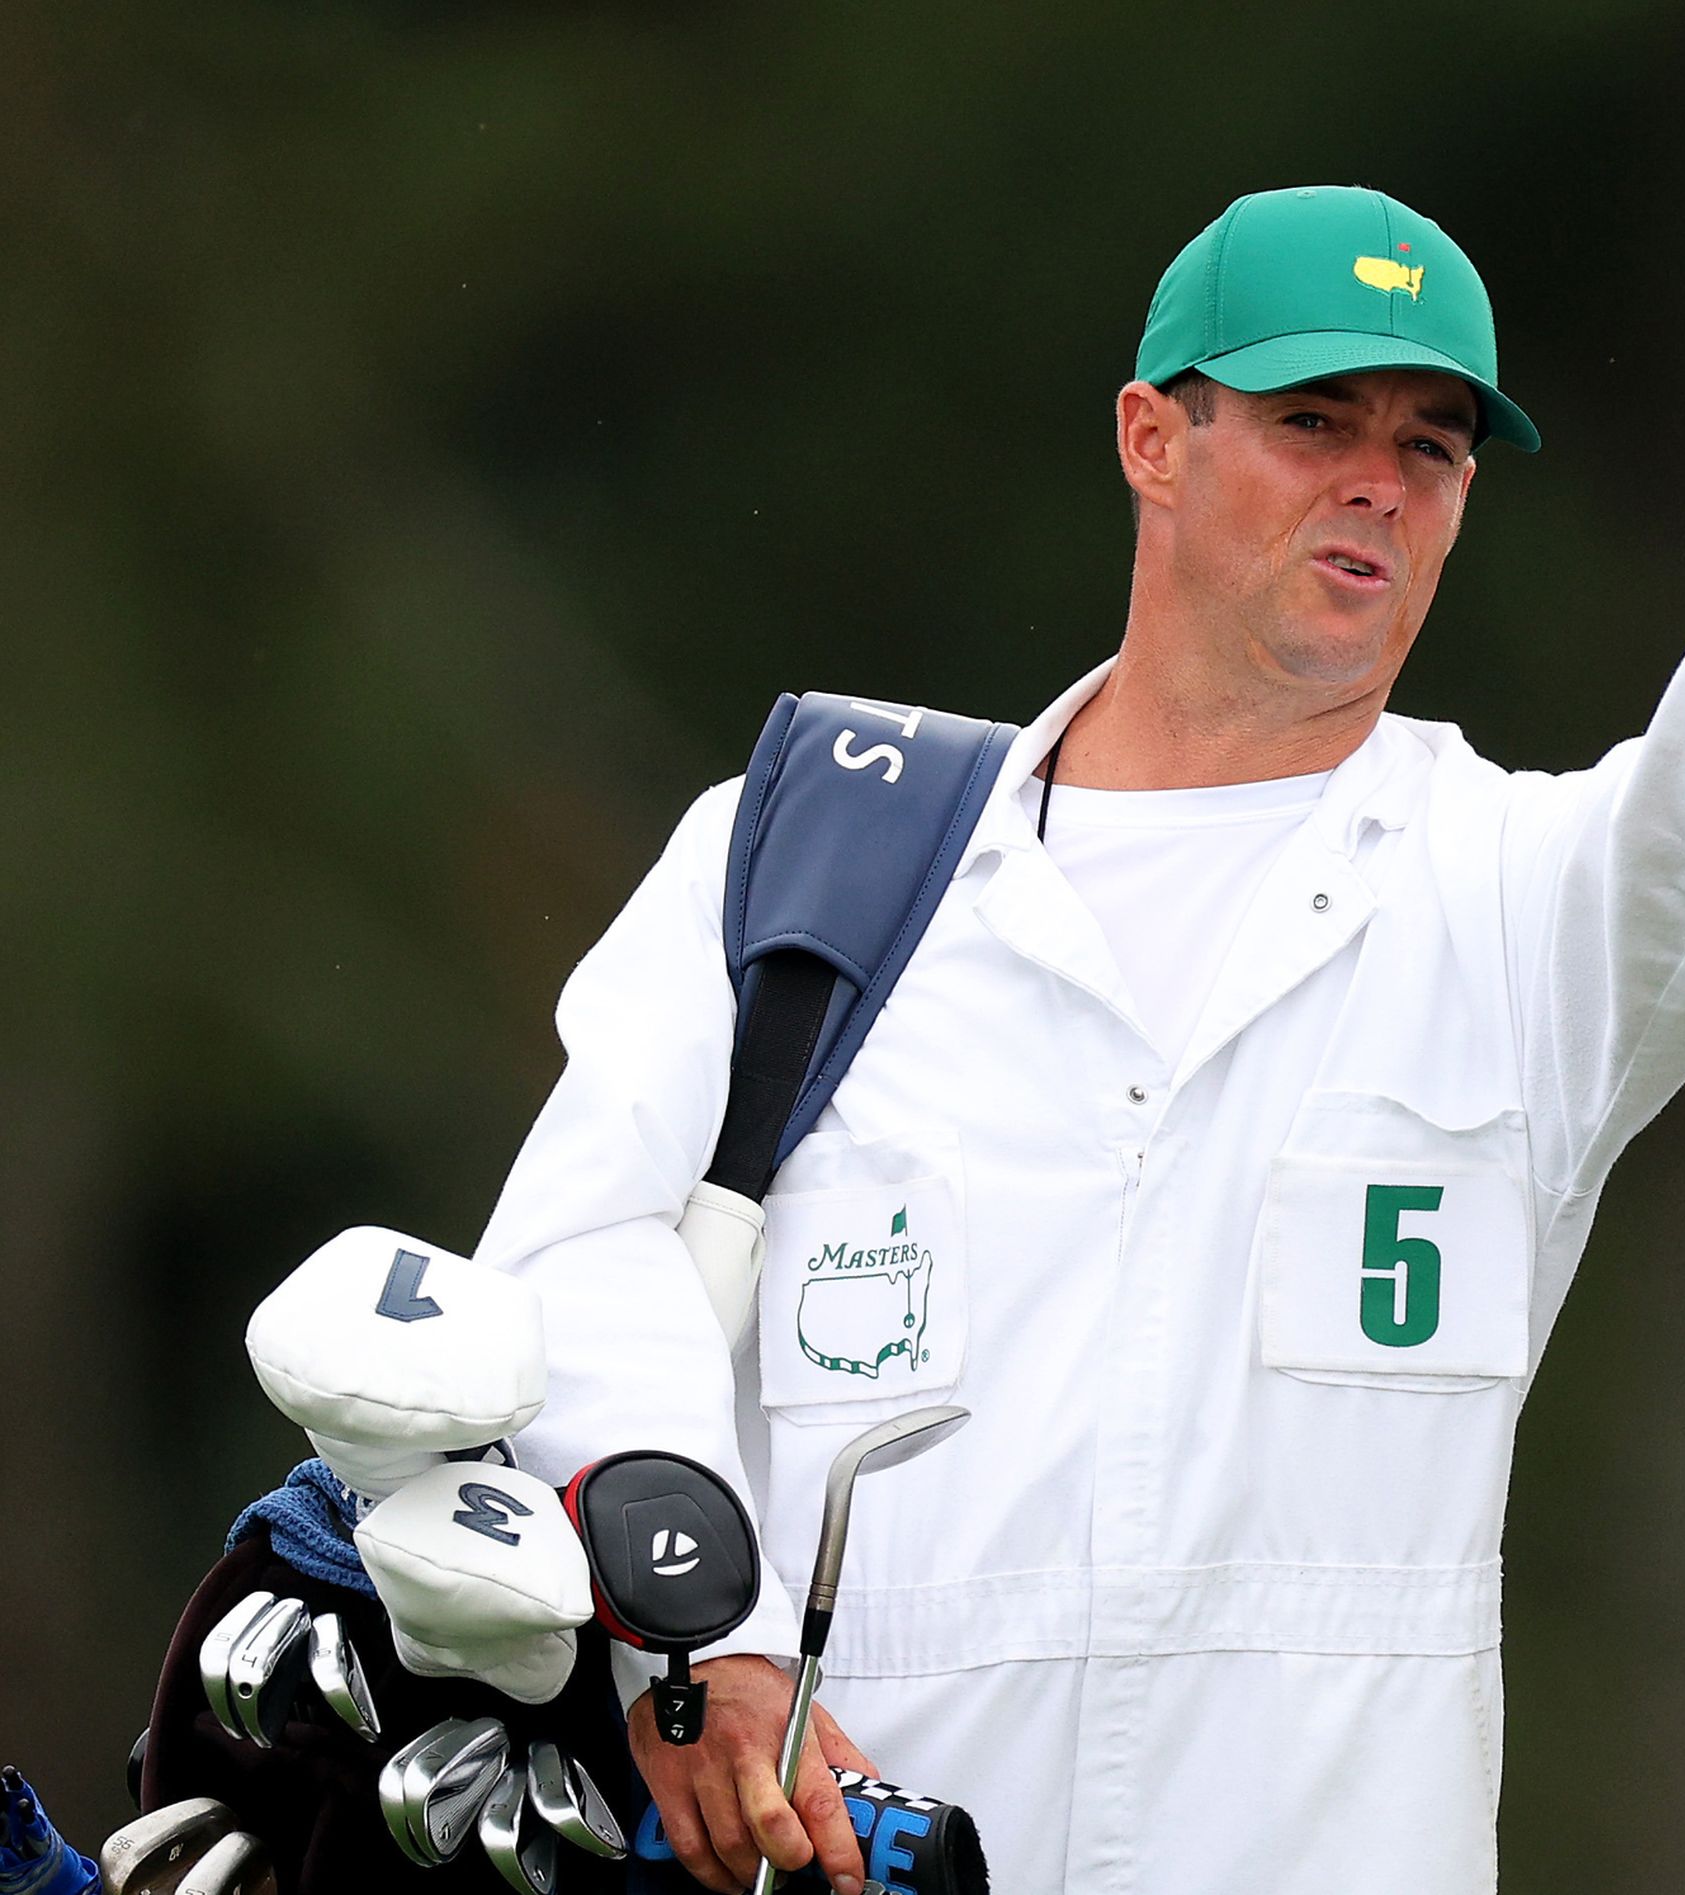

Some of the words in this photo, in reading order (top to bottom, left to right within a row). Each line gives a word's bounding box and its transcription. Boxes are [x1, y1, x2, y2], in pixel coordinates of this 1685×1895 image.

[375, 1248, 443, 1322] 1
[1360, 1184, 1444, 1347] 5
[453, 1482, 534, 1546] 3
[672, 1700, 685, 1712] 7
